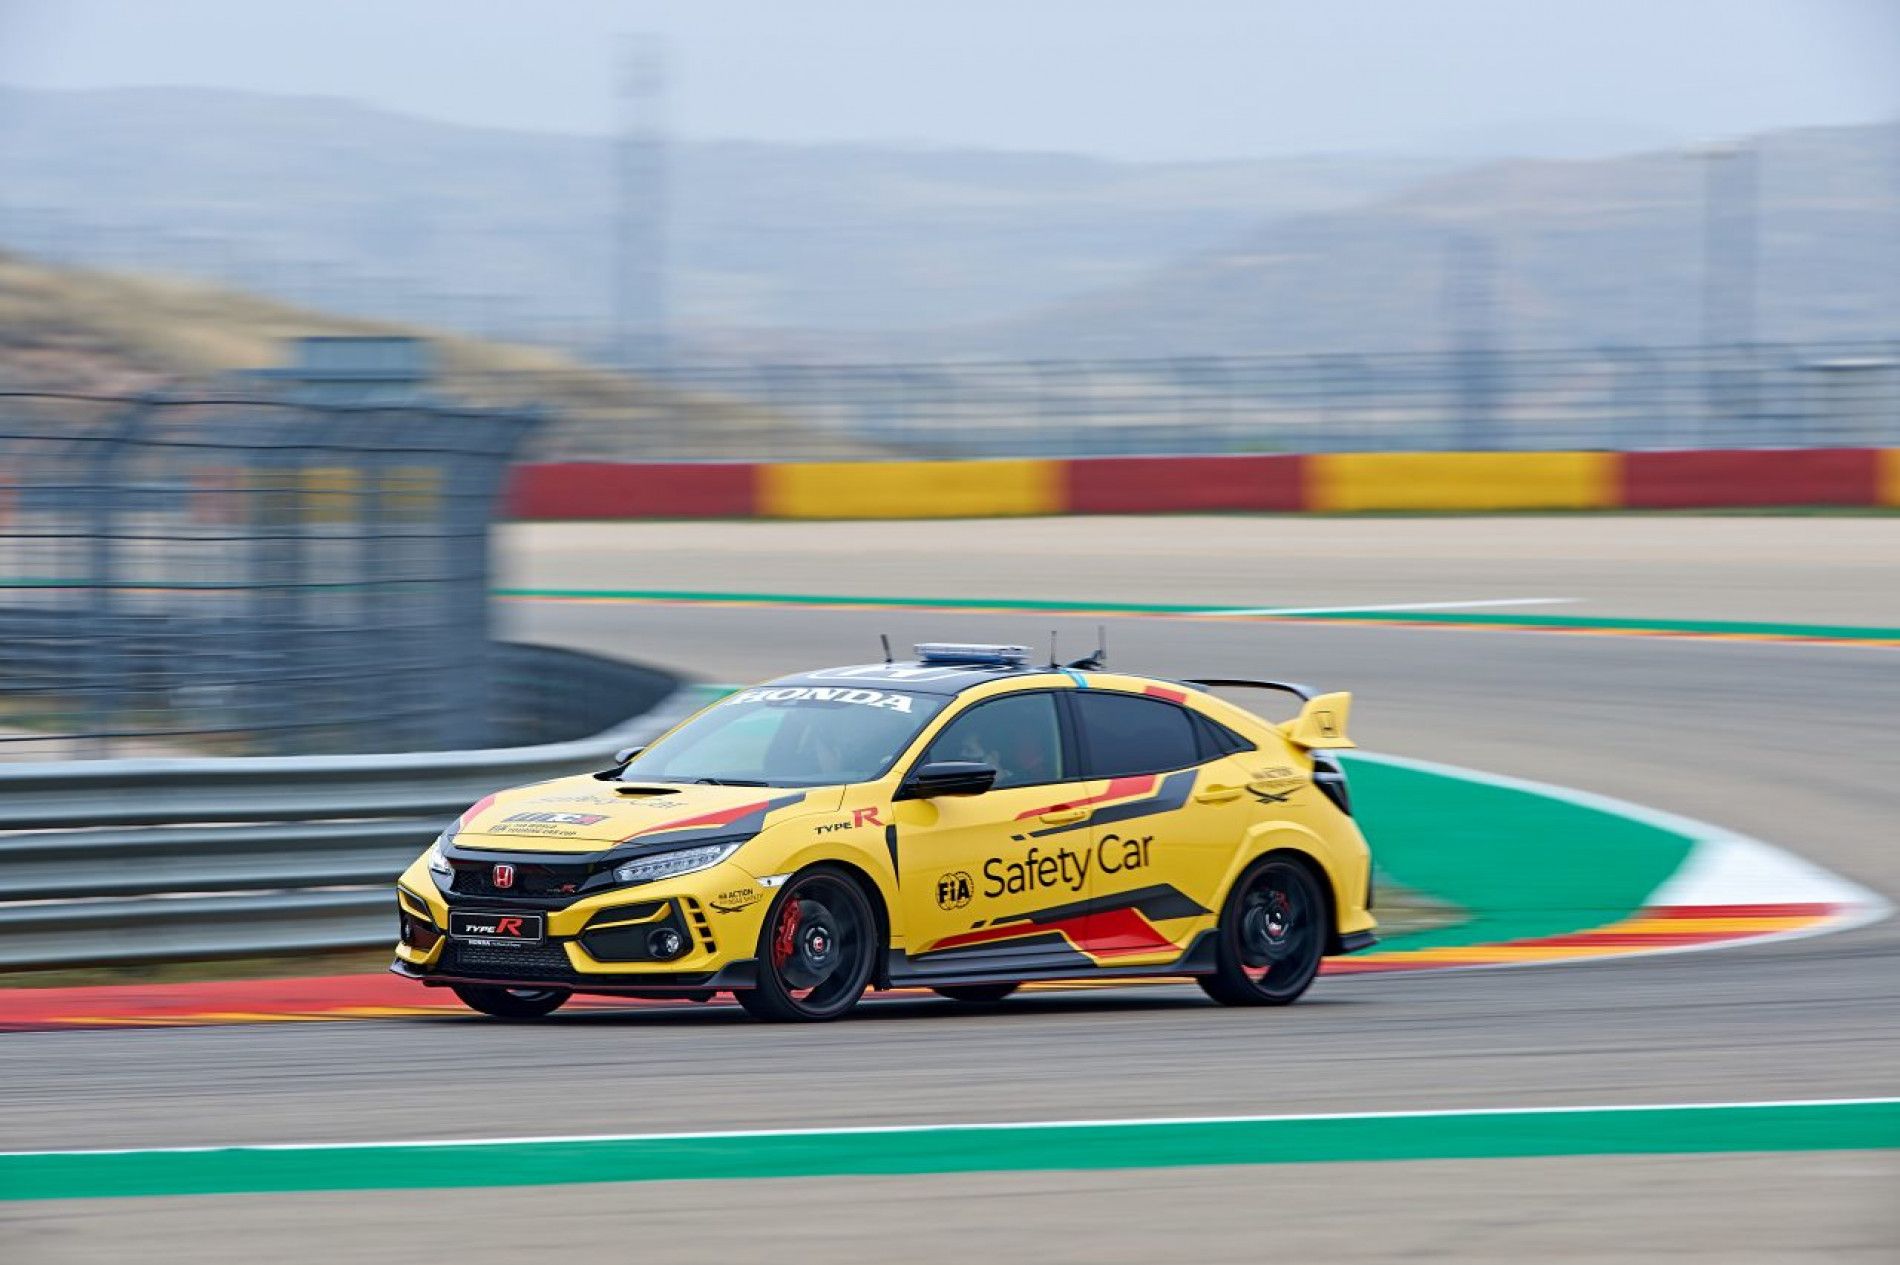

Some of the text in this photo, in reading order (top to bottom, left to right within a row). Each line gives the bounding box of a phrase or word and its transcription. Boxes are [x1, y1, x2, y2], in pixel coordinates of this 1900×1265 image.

[727, 686, 913, 714] HONDA
[814, 806, 886, 835] TYPE R
[983, 833, 1154, 898] Safety Car
[465, 917, 524, 937] TYPE R
